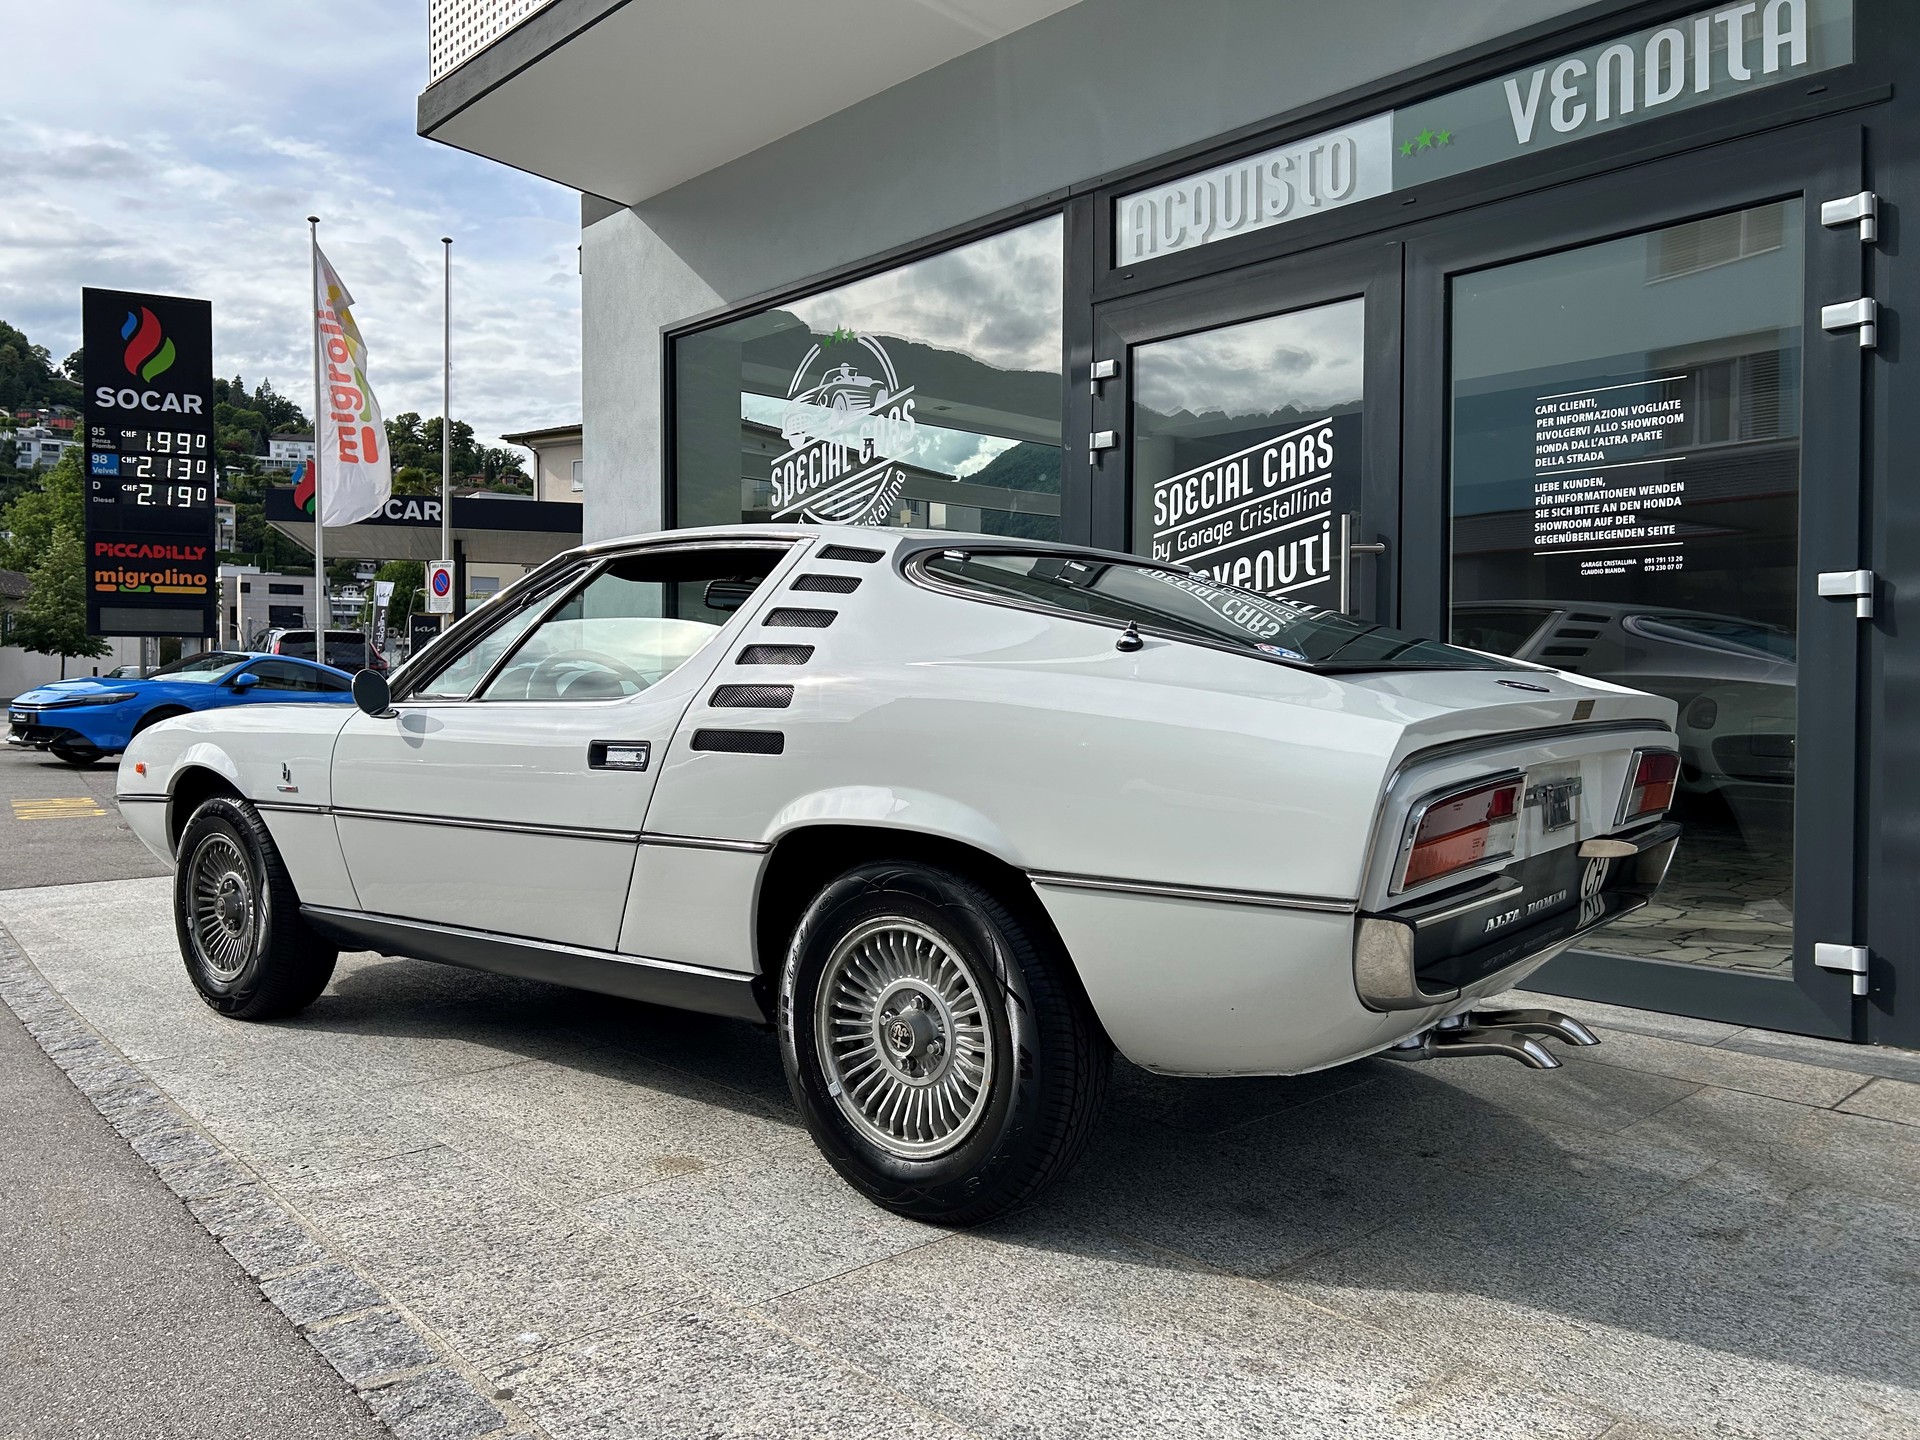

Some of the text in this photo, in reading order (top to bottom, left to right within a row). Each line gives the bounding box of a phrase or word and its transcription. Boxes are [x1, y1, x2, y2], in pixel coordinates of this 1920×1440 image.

[1503, 0, 1807, 144] VENDITA
[1129, 135, 1354, 257] ACQUISTO
[95, 386, 203, 415] SOCAR
[1535, 398, 1598, 415] CARI CLIENTI,
[1536, 400, 1681, 428] PER INFORMAZIONI VOGLIATE
[91, 427, 105, 436] 95
[121, 430, 138, 438] CHF
[1536, 413, 1684, 441] RIVOLGERVI ALLO SHOWROOM
[771, 398, 915, 507] SPECIAL CARS
[1536, 443, 1569, 454] HONDA
[1631, 430, 1663, 442] PARTE
[92, 454, 108, 464] 98
[1535, 451, 1605, 467] DELLA STRADA
[92, 467, 118, 475] Velvet
[1153, 427, 1333, 526] SPECIAL CARS
[92, 481, 101, 490] D
[121, 484, 138, 492] CHF
[1534, 477, 1606, 493] LIEBE KUNDEN,
[1535, 481, 1685, 506] FÜR INFORMATIONEN WENDEN
[1535, 496, 1682, 519] SIE SICH BITTE AN DEN HONDA
[1153, 487, 1332, 563] by Garage Cristallina
[1534, 515, 1636, 532] SHOWROOM AUF DER
[1534, 525, 1676, 545] GEGENÜBERLIEGENDEN SEITE
[1197, 520, 1331, 594] venuti
[1580, 560, 1603, 568] GARAGE
[1603, 559, 1637, 567] CRISTALLINA
[95, 566, 207, 588] migrolino
[1484, 889, 1567, 933] ALFA ROMEO
